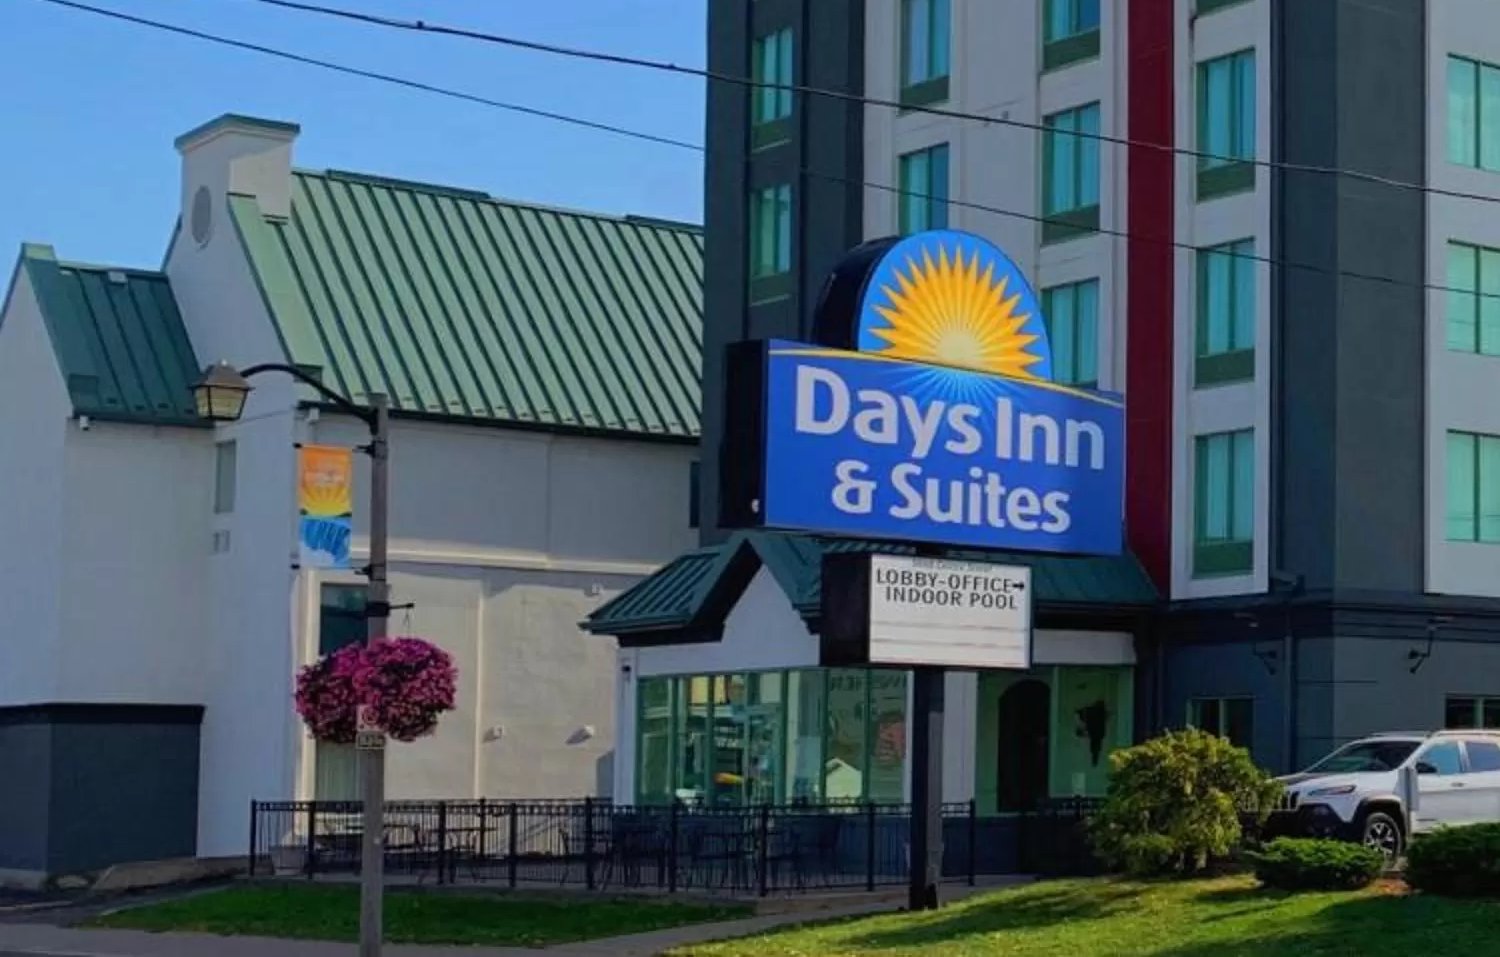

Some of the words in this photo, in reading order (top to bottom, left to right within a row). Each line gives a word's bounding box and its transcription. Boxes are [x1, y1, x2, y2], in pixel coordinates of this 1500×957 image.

[796, 364, 982, 458] Days
[996, 398, 1104, 470] Inn
[831, 459, 877, 514] &
[890, 463, 1071, 533] Suites
[876, 568, 1013, 593] LOBBY-OFFICE
[885, 586, 963, 606] INDOOR
[969, 592, 1018, 610] POOL
